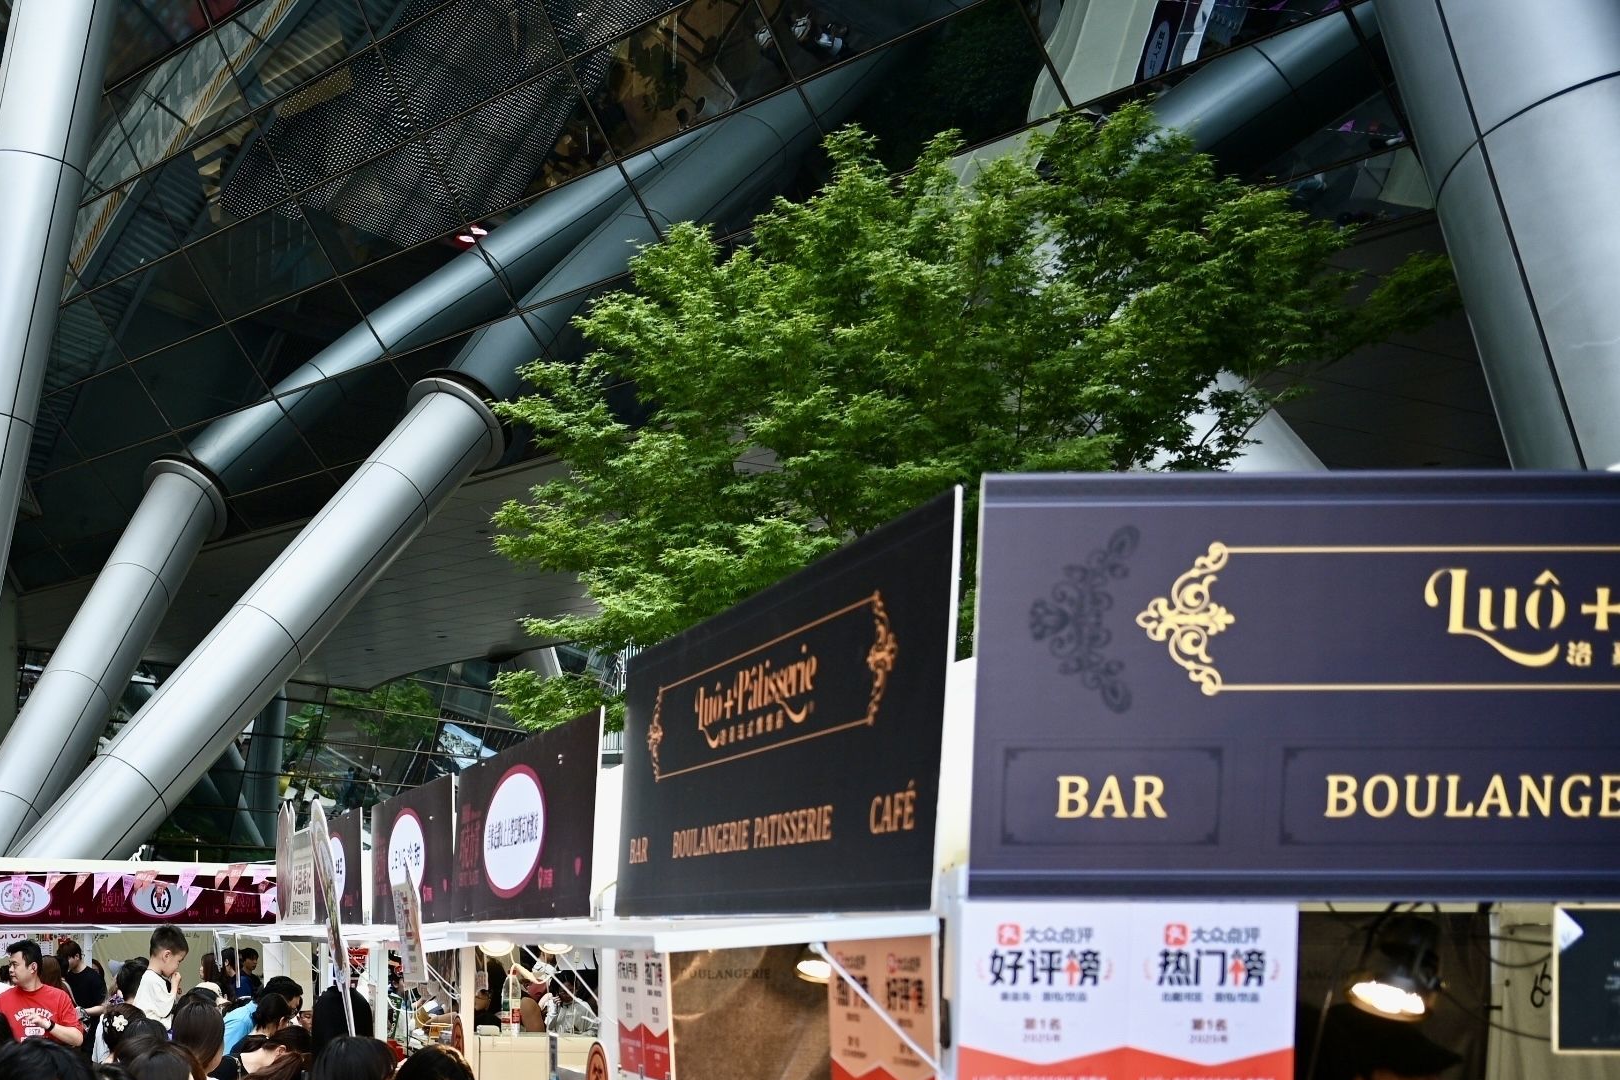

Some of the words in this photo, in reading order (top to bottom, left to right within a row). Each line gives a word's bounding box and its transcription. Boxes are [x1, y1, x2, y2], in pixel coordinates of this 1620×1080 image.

[1566, 641, 1620, 667] 洛
[1054, 776, 1168, 820] BAR
[1325, 774, 1620, 819] BOULANGE
[629, 836, 648, 864] BAR
[672, 818, 751, 858] BOULANGERIE
[753, 804, 834, 849] PATISSERIE
[869, 778, 917, 834] CAFÉ
[1024, 926, 1094, 944] 大众点评
[1190, 926, 1261, 944] 大众点评
[989, 948, 1101, 987] 好评榜
[1157, 948, 1267, 987] 热门榜
